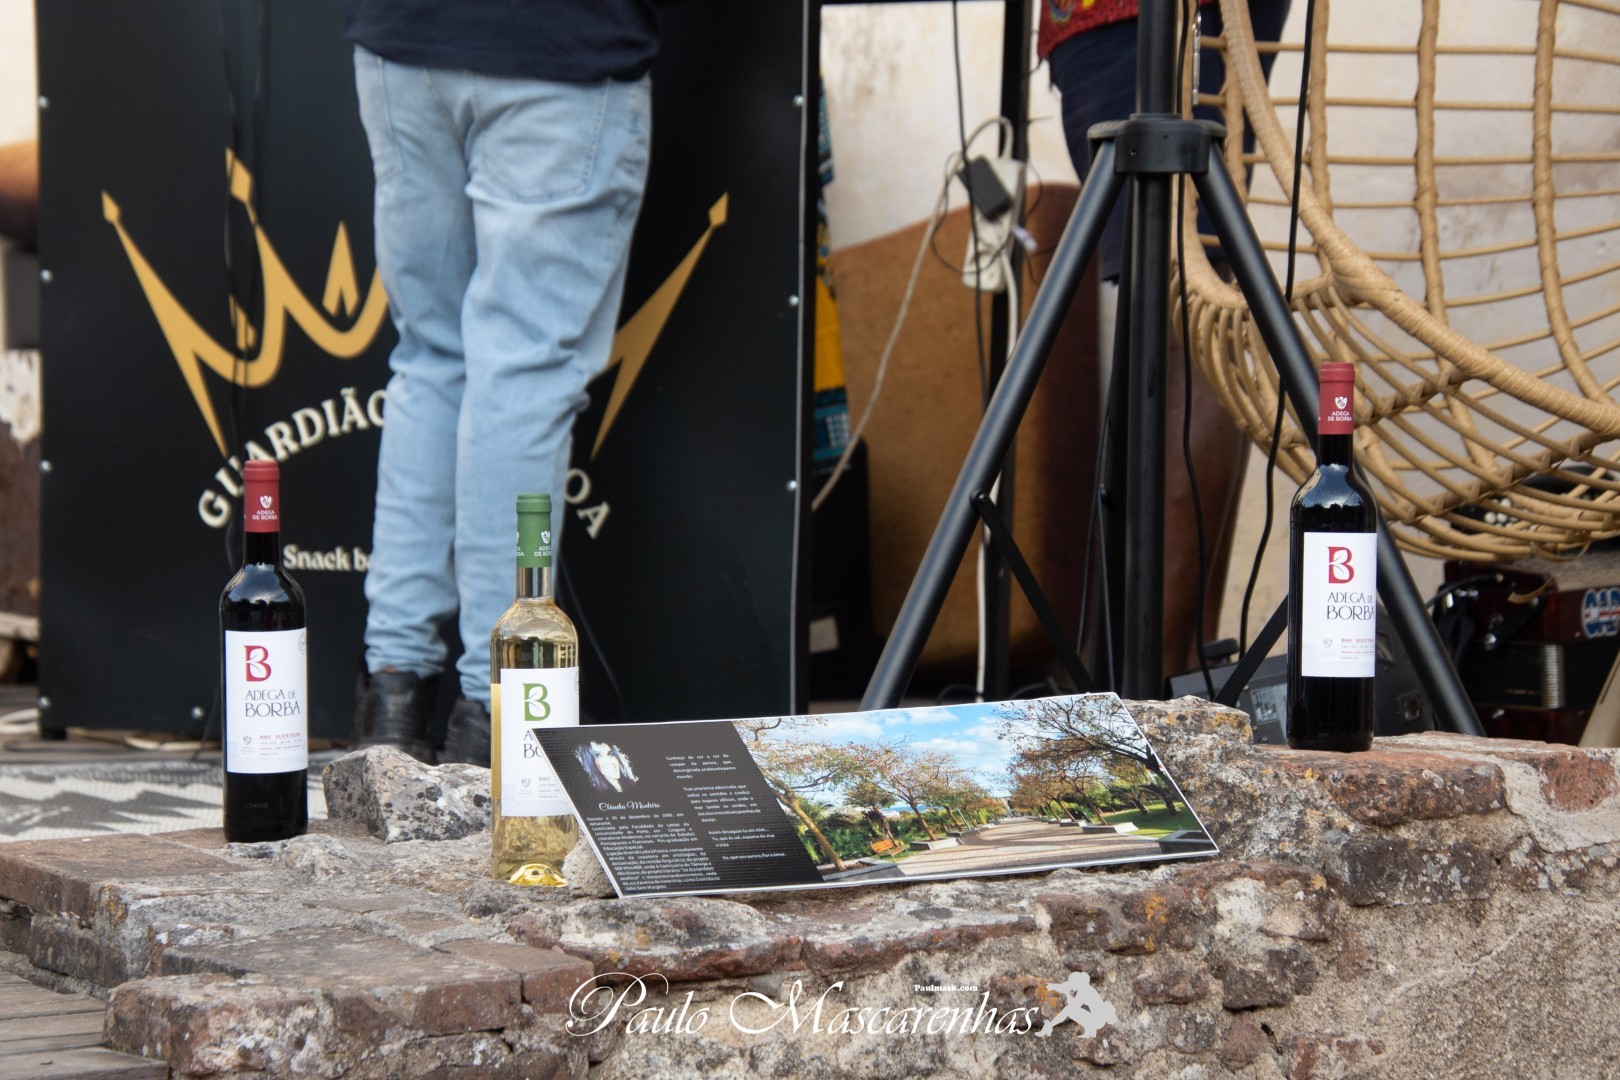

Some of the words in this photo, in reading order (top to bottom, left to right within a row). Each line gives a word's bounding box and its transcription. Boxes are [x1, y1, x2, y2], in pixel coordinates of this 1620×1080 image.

[282, 544, 351, 572] Snack
[1327, 546, 1354, 584] B
[1327, 592, 1365, 603] ADEGA
[1326, 605, 1374, 620] BORBA
[244, 645, 272, 682] B
[246, 690, 285, 700] ADEGA
[289, 690, 296, 699] DE
[522, 683, 550, 721] B
[245, 700, 300, 717] BORBA
